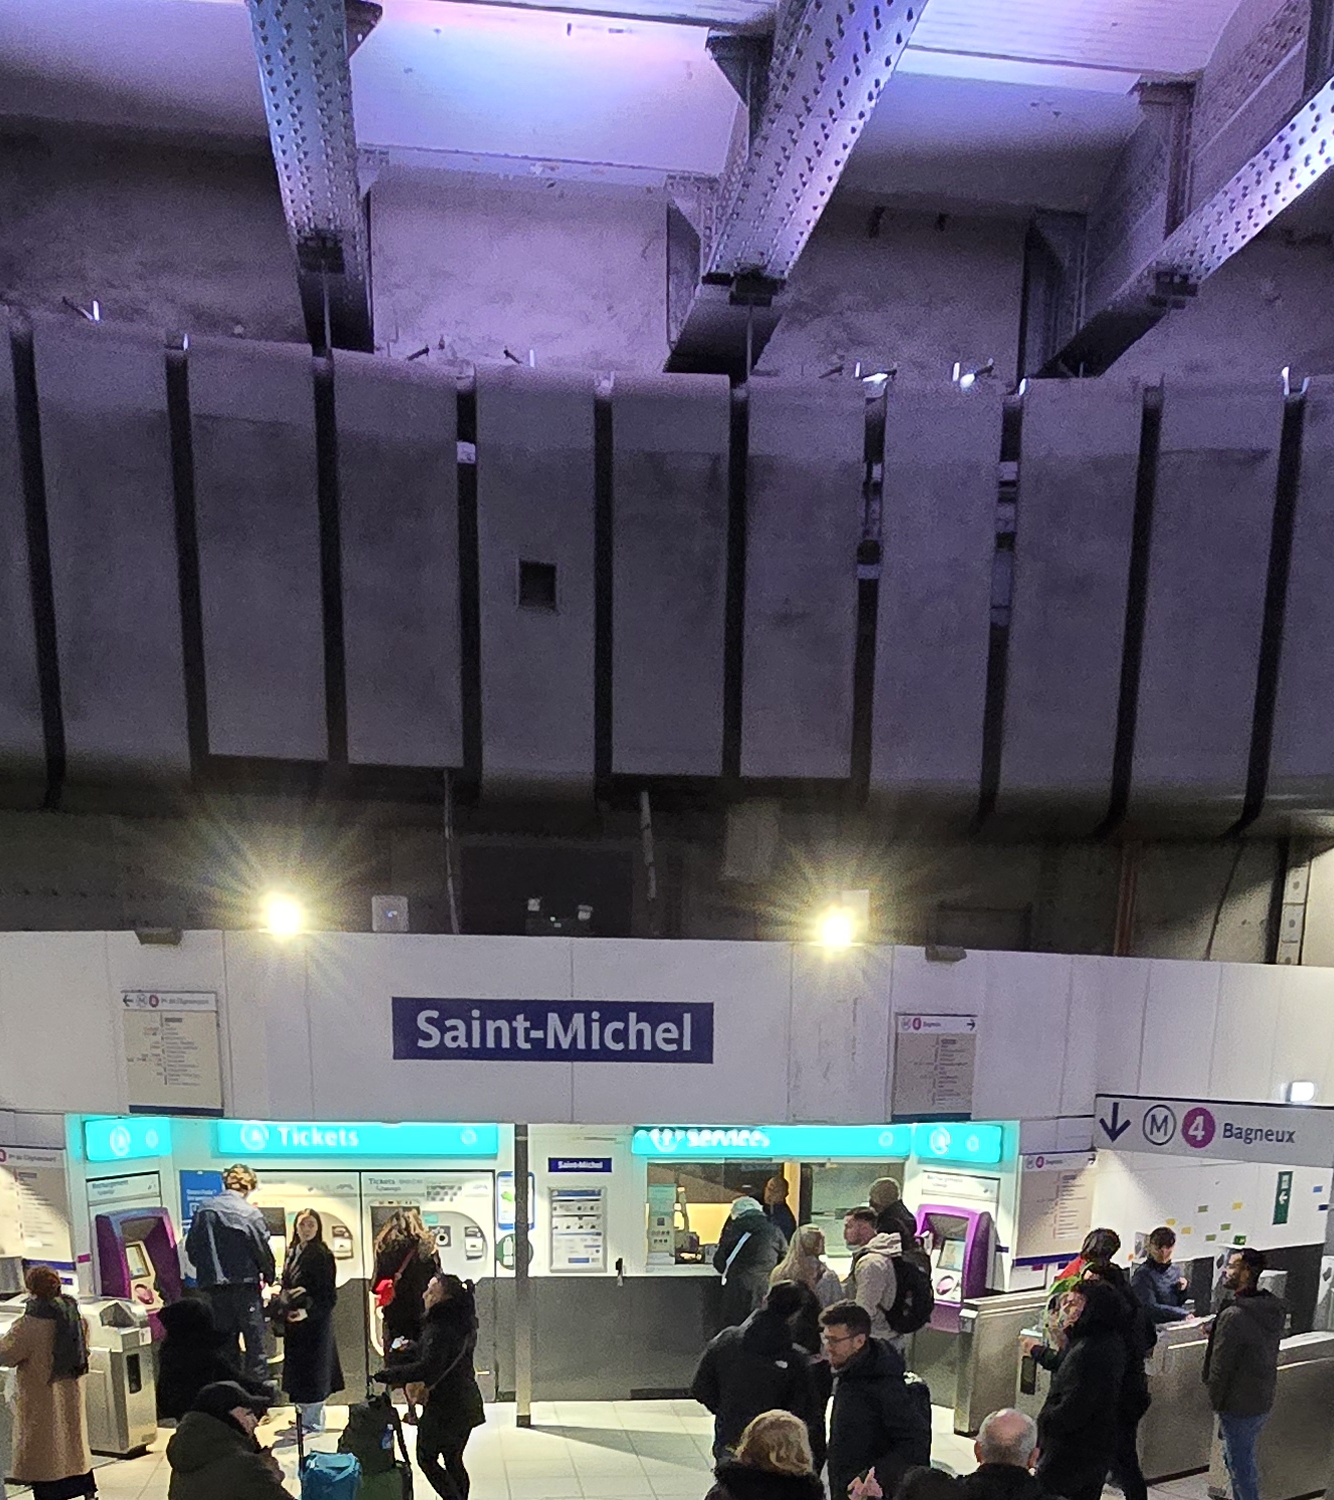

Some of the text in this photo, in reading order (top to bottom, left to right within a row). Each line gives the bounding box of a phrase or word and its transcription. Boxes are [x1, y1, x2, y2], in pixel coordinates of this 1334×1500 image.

[416, 1008, 692, 1052] Saint-Michel
[276, 1126, 360, 1147] Tickets
[1188, 1115, 1205, 1141] 4
[1222, 1121, 1297, 1145] Bagneux
